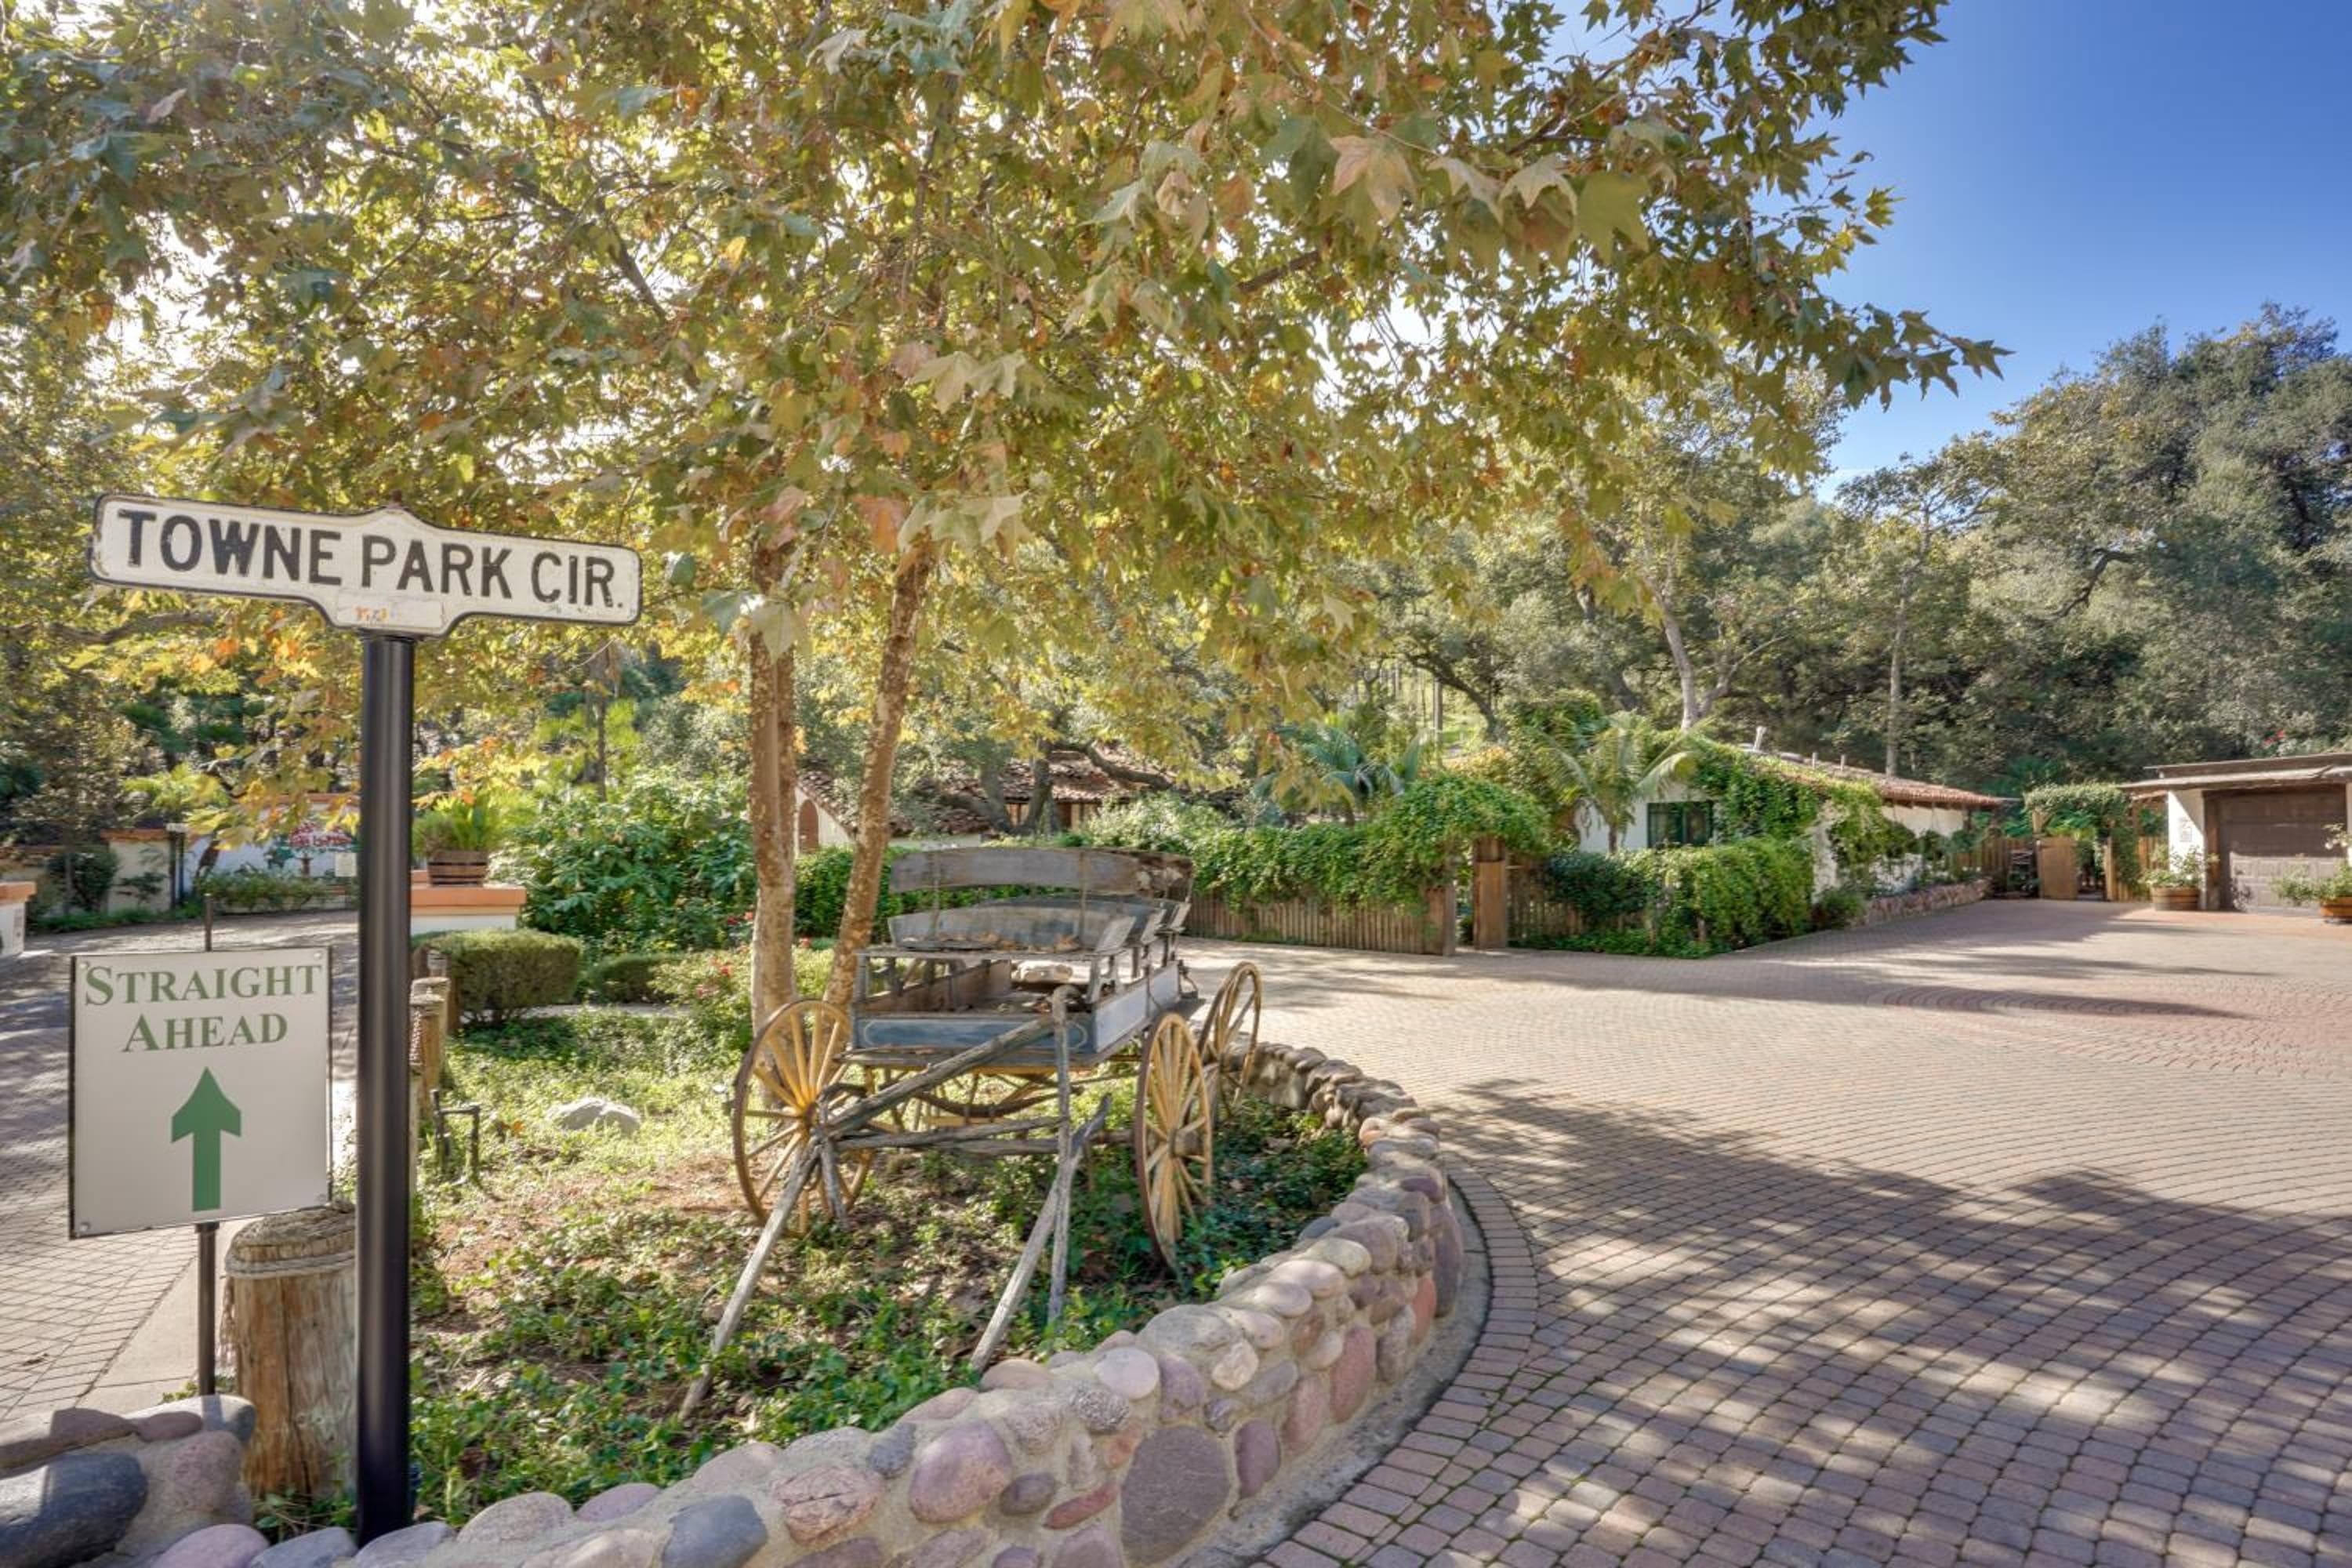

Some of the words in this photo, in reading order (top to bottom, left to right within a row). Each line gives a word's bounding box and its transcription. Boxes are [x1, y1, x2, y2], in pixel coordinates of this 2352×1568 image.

[118, 508, 342, 587] TOWNE
[361, 535, 514, 600] PARK
[530, 551, 626, 610] CIR.
[84, 964, 323, 1006] STRAIGHT
[120, 1013, 289, 1053] AHEAD
